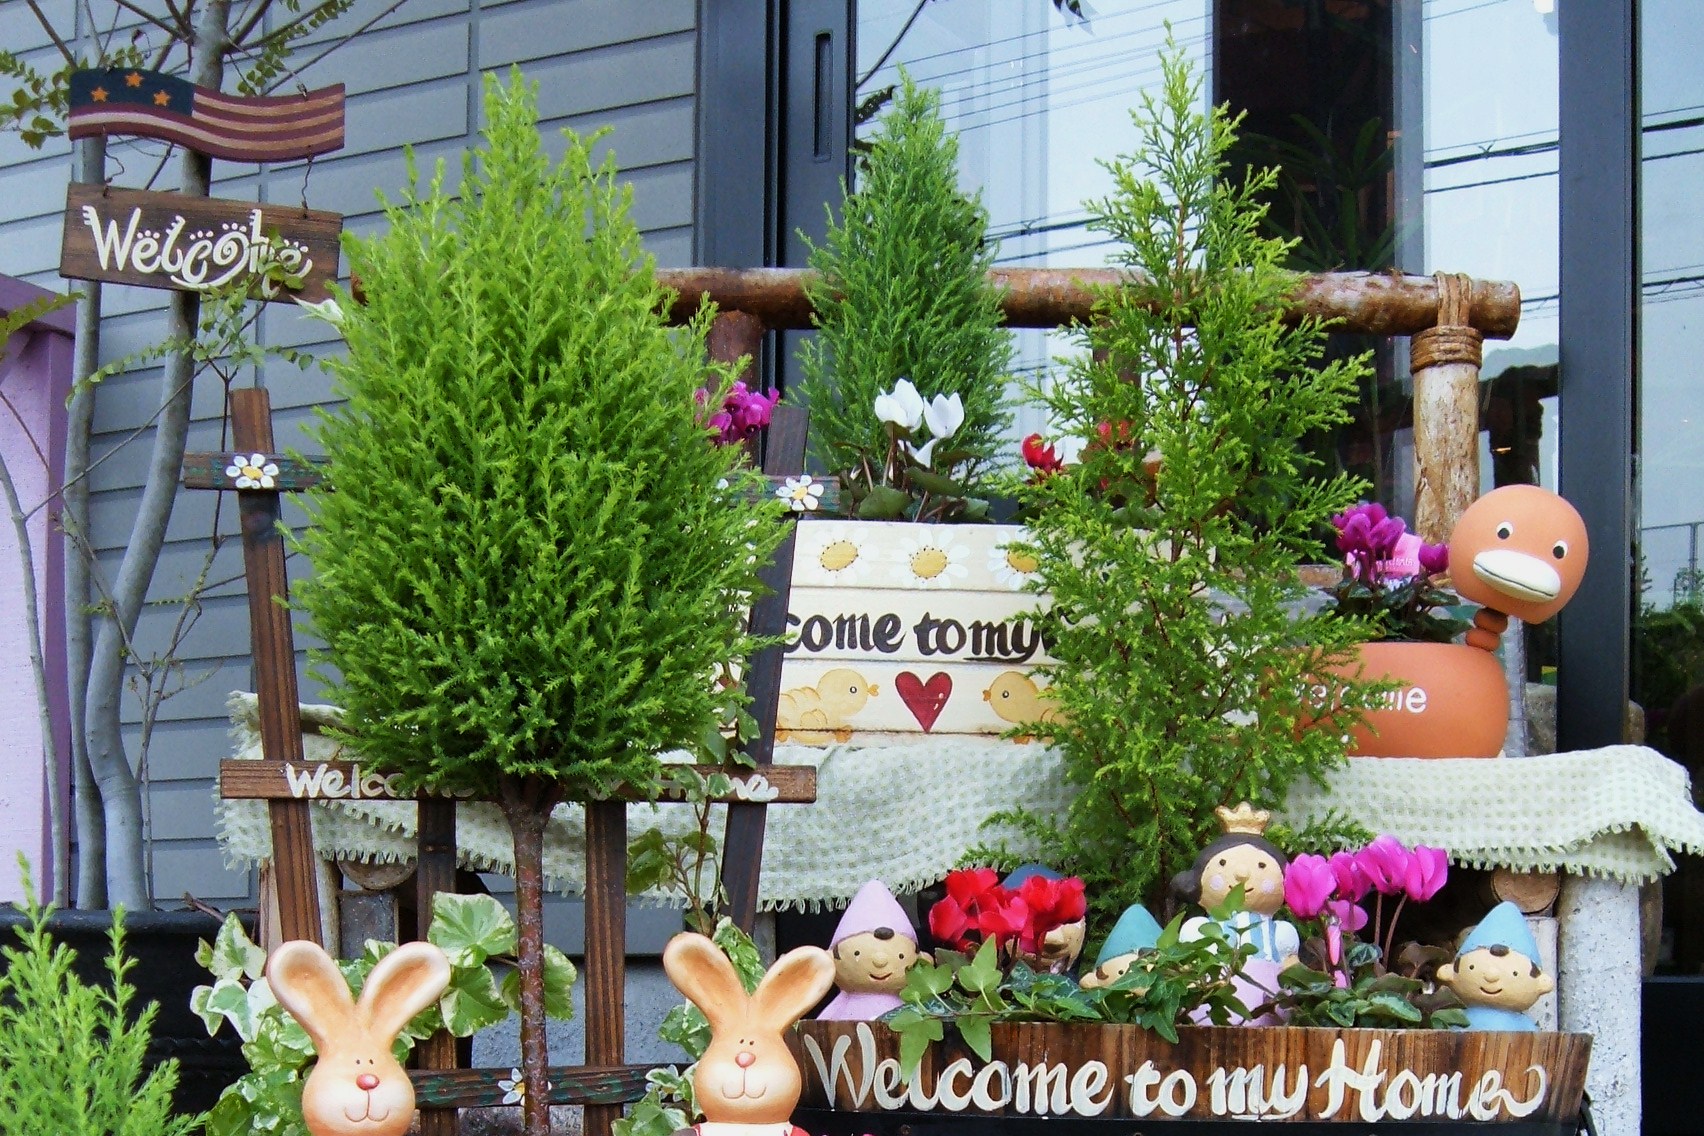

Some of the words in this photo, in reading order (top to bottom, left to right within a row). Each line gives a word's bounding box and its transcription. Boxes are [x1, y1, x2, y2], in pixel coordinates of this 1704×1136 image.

[782, 612, 905, 654] come
[913, 611, 967, 656] to
[963, 619, 1041, 664] my
[803, 1021, 1115, 1118] Welcome
[1124, 1059, 1197, 1117] to
[1206, 1063, 1308, 1121] my
[1314, 1037, 1547, 1122] Home
